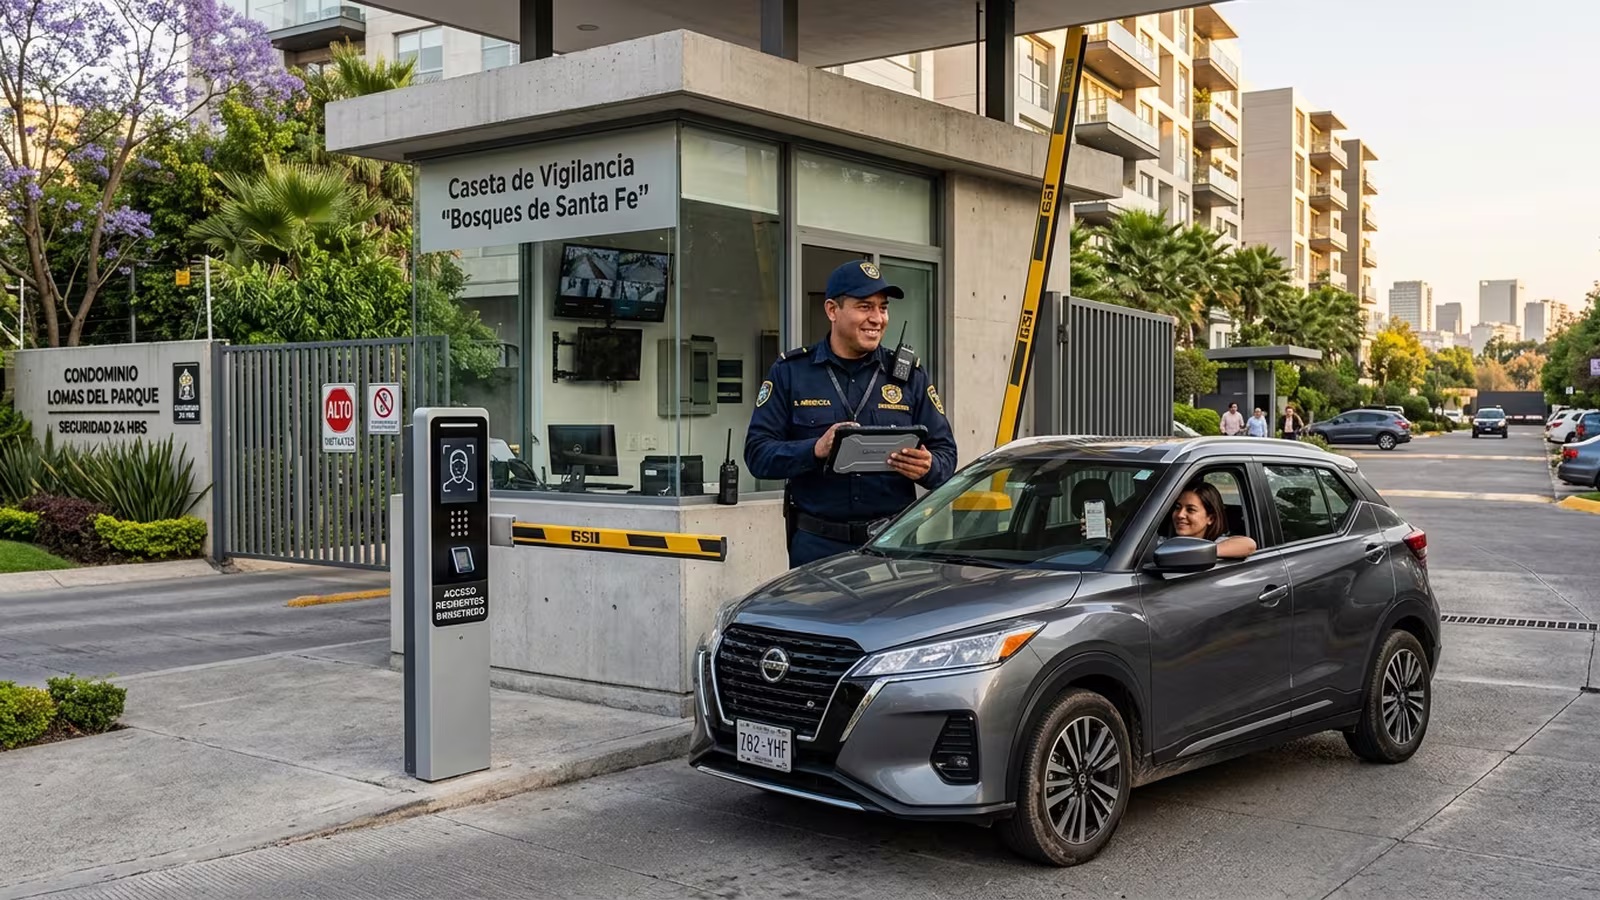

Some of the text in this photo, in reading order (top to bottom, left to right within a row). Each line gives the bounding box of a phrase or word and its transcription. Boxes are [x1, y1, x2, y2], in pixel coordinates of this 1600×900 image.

[449, 153, 634, 199] Caseta de Vigilancia
[442, 184, 649, 230] “Bosques de Santa Fe”
[64, 365, 138, 383] CONDOMINIO
[47, 387, 159, 406] LOMAS DEL PARQUE
[327, 400, 352, 419] ALTO
[58, 420, 111, 434] SEGURIDAD
[113, 420, 125, 434] 24
